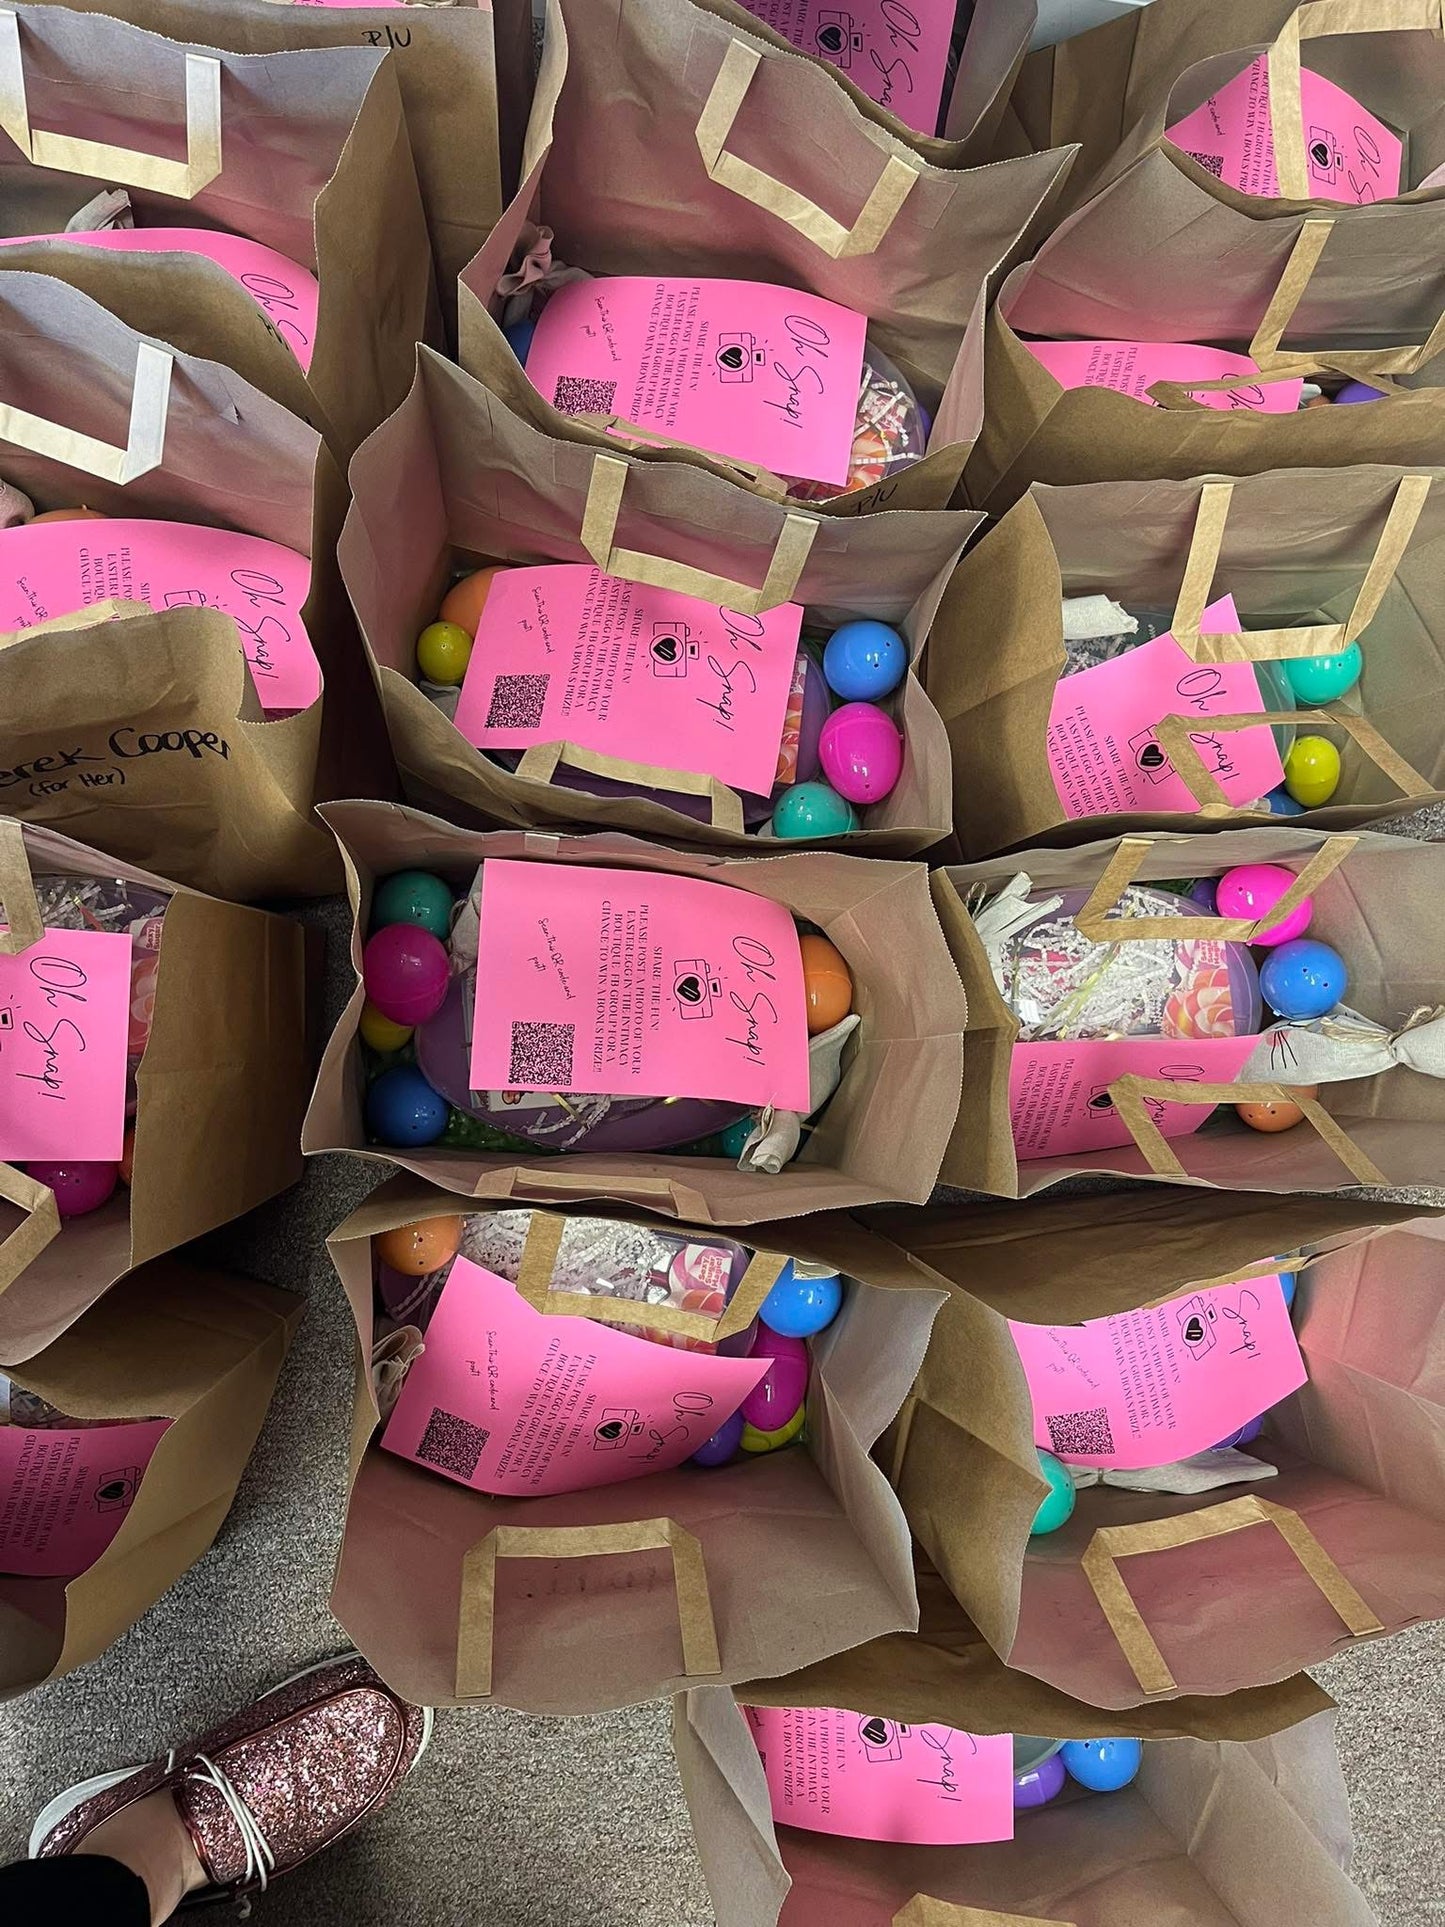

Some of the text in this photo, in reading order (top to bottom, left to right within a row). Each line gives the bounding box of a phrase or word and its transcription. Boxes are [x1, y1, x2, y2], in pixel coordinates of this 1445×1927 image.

[870, 50, 913, 107] Sna
[1353, 126, 1382, 178] Oh
[241, 274, 299, 311] Oh
[762, 314, 832, 430] Oh Snap!
[79, 547, 91, 587] CHANCE
[107, 553, 119, 592] EASTER
[120, 547, 132, 582] PLEASE
[585, 567, 600, 604] CHANCE
[230, 569, 291, 679] Oh Snap!
[578, 622, 588, 640] WIN
[582, 606, 592, 620] TO
[603, 613, 615, 633] EGG
[615, 607, 628, 630] POST
[630, 608, 644, 639] SHARE
[577, 578, 610, 699] BOUTIQUE FB GROUP FOR
[596, 647, 608, 666] THE
[601, 635, 611, 644] IN
[626, 642, 637, 660] THE
[568, 651, 583, 683] BONUS
[607, 643, 621, 677] PHOTO
[587, 668, 604, 712] INTIMACY
[604, 678, 614, 692] OF
[695, 654, 757, 732] Snap!
[1176, 668, 1227, 712] Oh
[598, 694, 611, 721] YOUR
[108, 728, 231, 760] Cooper
[1065, 716, 1094, 774] EASTER EGG
[1075, 705, 1105, 766] PLEASE POST
[1104, 735, 1121, 767] SHARE
[30, 767, 124, 797] (for Her)
[600, 900, 611, 942] CHANCE
[638, 904, 649, 943] PLEASE
[600, 945, 609, 961] TO
[611, 913, 623, 968] BOUTIQUE
[598, 964, 608, 984] WIN
[637, 946, 647, 973] POST
[653, 946, 662, 980] SHARE
[611, 973, 620, 987] FB
[619, 910, 636, 1066] EASTER EGG IN THE INTIMACY
[651, 983, 661, 1005] THE
[595, 998, 606, 1034] BONUS
[608, 989, 619, 1028] GROUP
[634, 987, 645, 1025] PHOTO
[724, 934, 778, 1067] Oh Snap!
[15, 956, 88, 1100] Oh Snap!
[607, 1030, 617, 1052] FOR
[633, 1027, 642, 1041] OF
[632, 1045, 642, 1074] YOUR
[1222, 1289, 1262, 1361] Snap!
[629, 1390, 714, 1466] Oh Snap!
[784, 1731, 793, 1767] BONUS
[795, 1725, 804, 1764] GROUP
[808, 1754, 818, 1803] INTIMACY
[820, 1726, 830, 1814] PHOTO YOUR
[917, 1729, 977, 1802] Snap!
